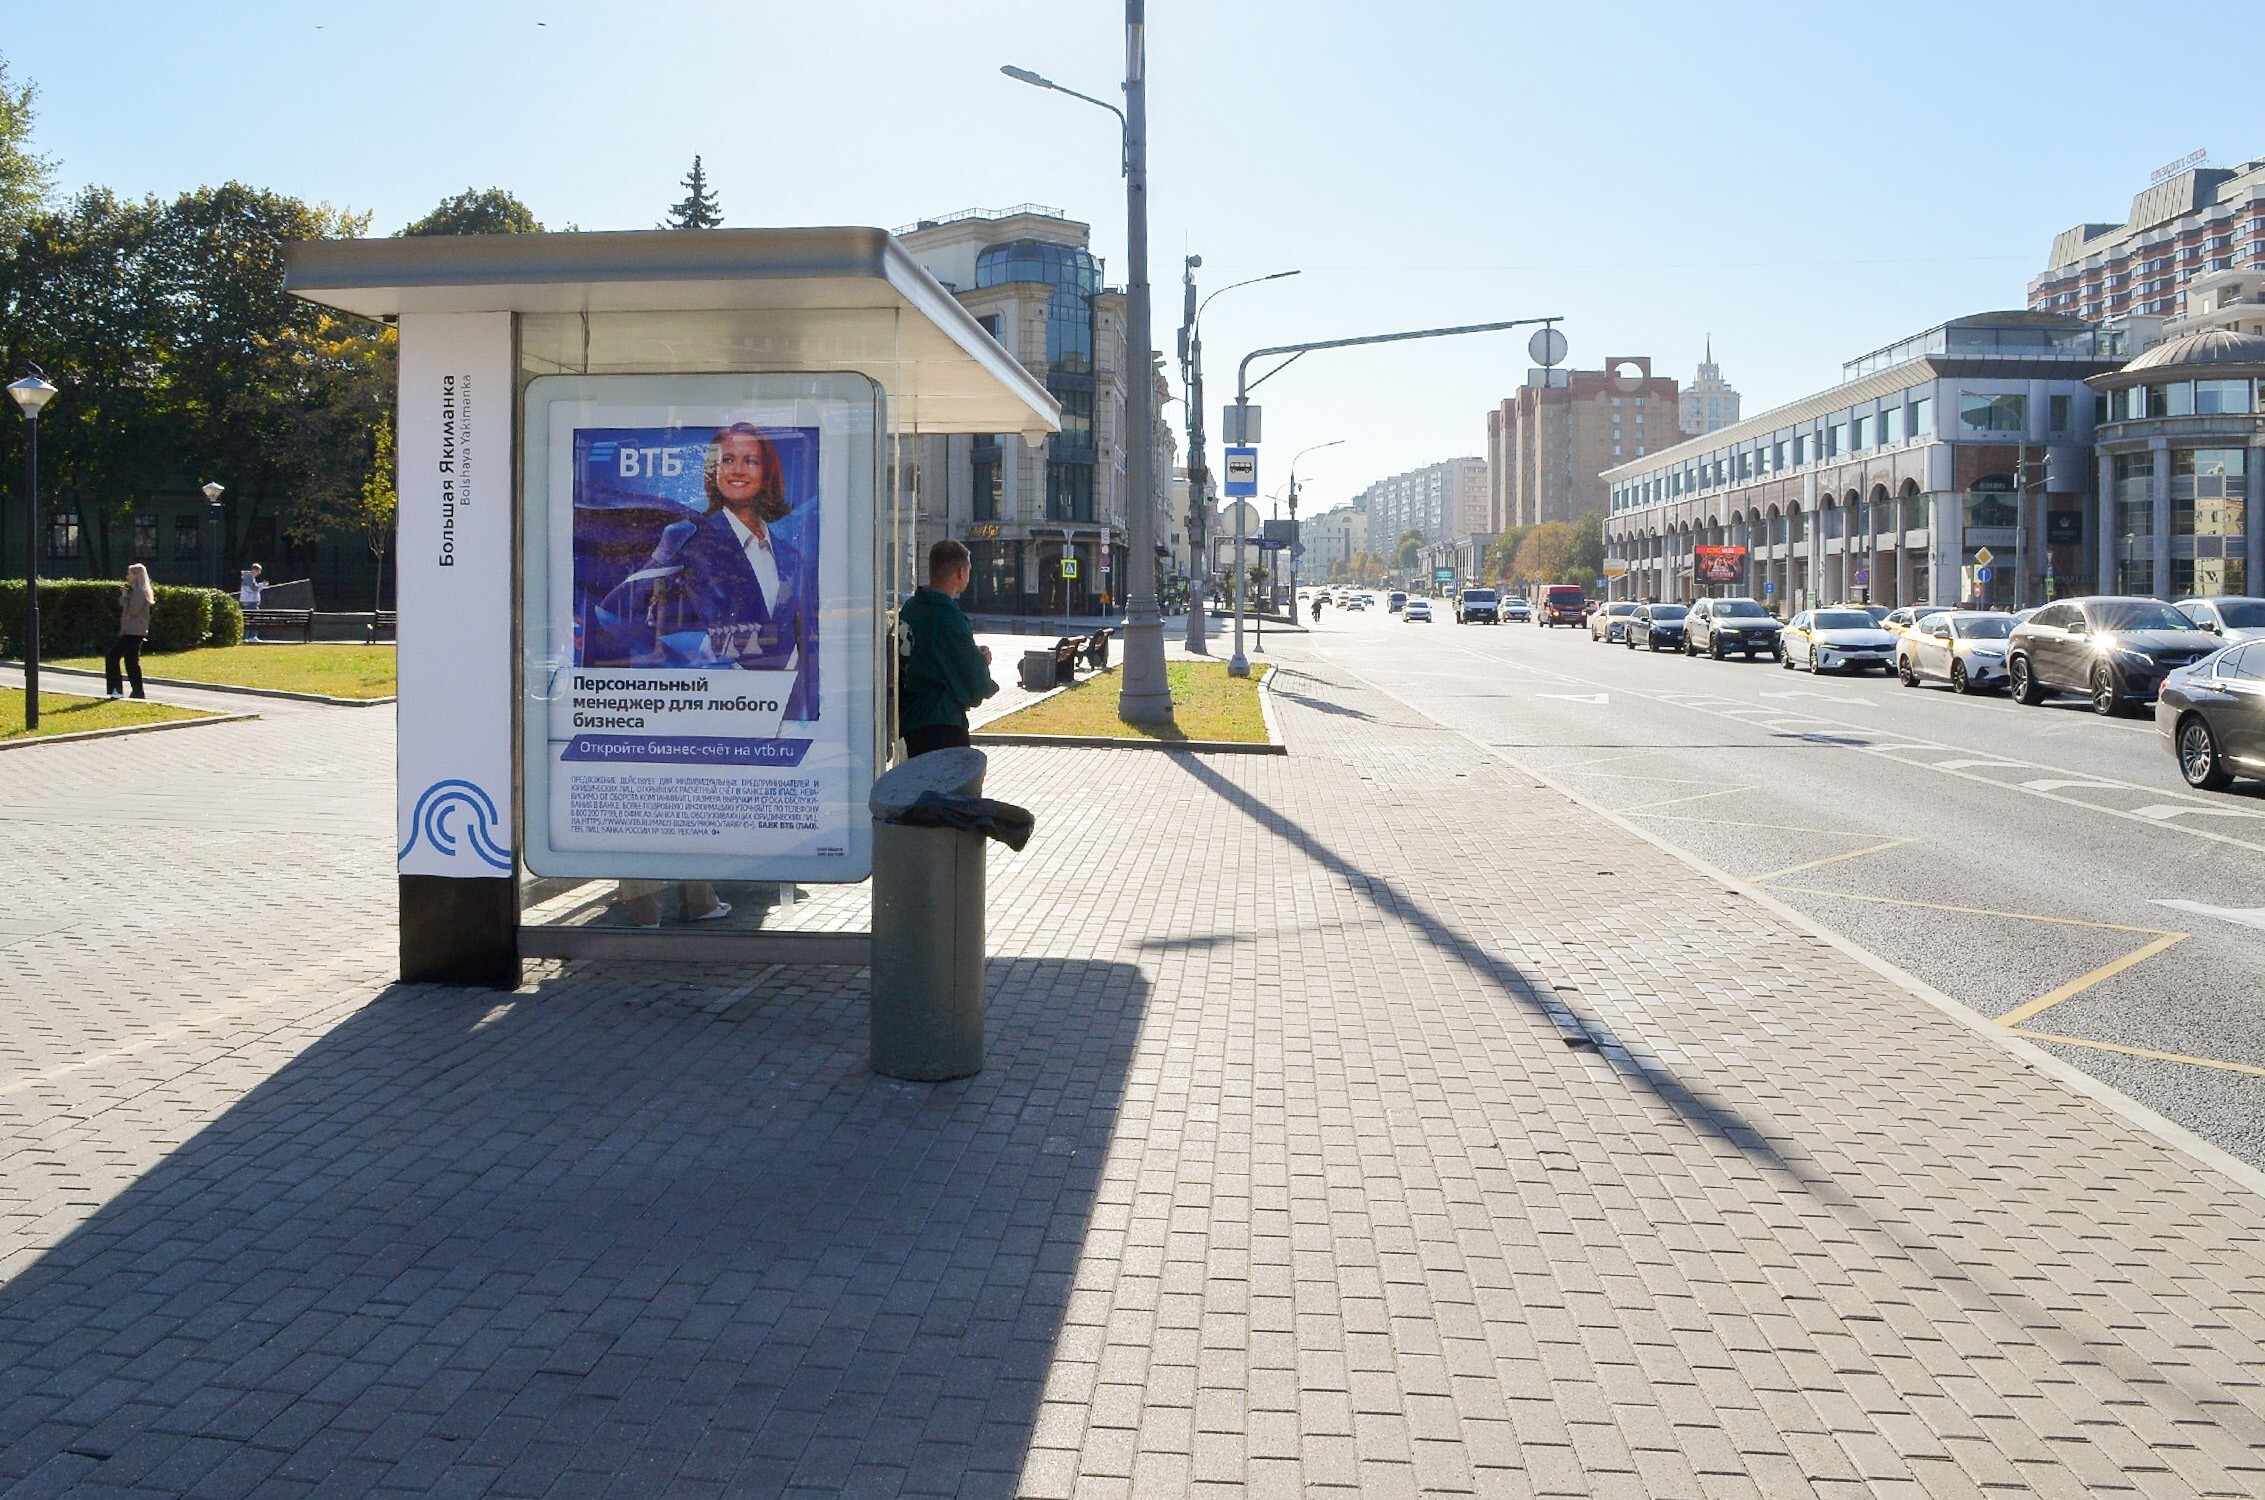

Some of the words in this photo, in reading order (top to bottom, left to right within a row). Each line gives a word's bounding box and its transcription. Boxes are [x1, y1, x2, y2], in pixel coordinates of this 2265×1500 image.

[460, 374, 472, 445] Yakimanka
[439, 375, 455, 474] Якиманка
[620, 447, 683, 477] ВТБ
[460, 448, 473, 506] Bolshaya
[439, 480, 455, 567] Большая
[573, 675, 709, 693] Персональный
[573, 696, 665, 713] менеджер
[668, 698, 703, 712] для
[707, 696, 779, 712] любого
[573, 713, 645, 729] бизнеса
[580, 741, 645, 756] Откройте
[648, 742, 730, 756] бизнес-счёт
[734, 747, 751, 756] на
[754, 745, 794, 757] vtb.ru
[757, 821, 778, 829] БАНК
